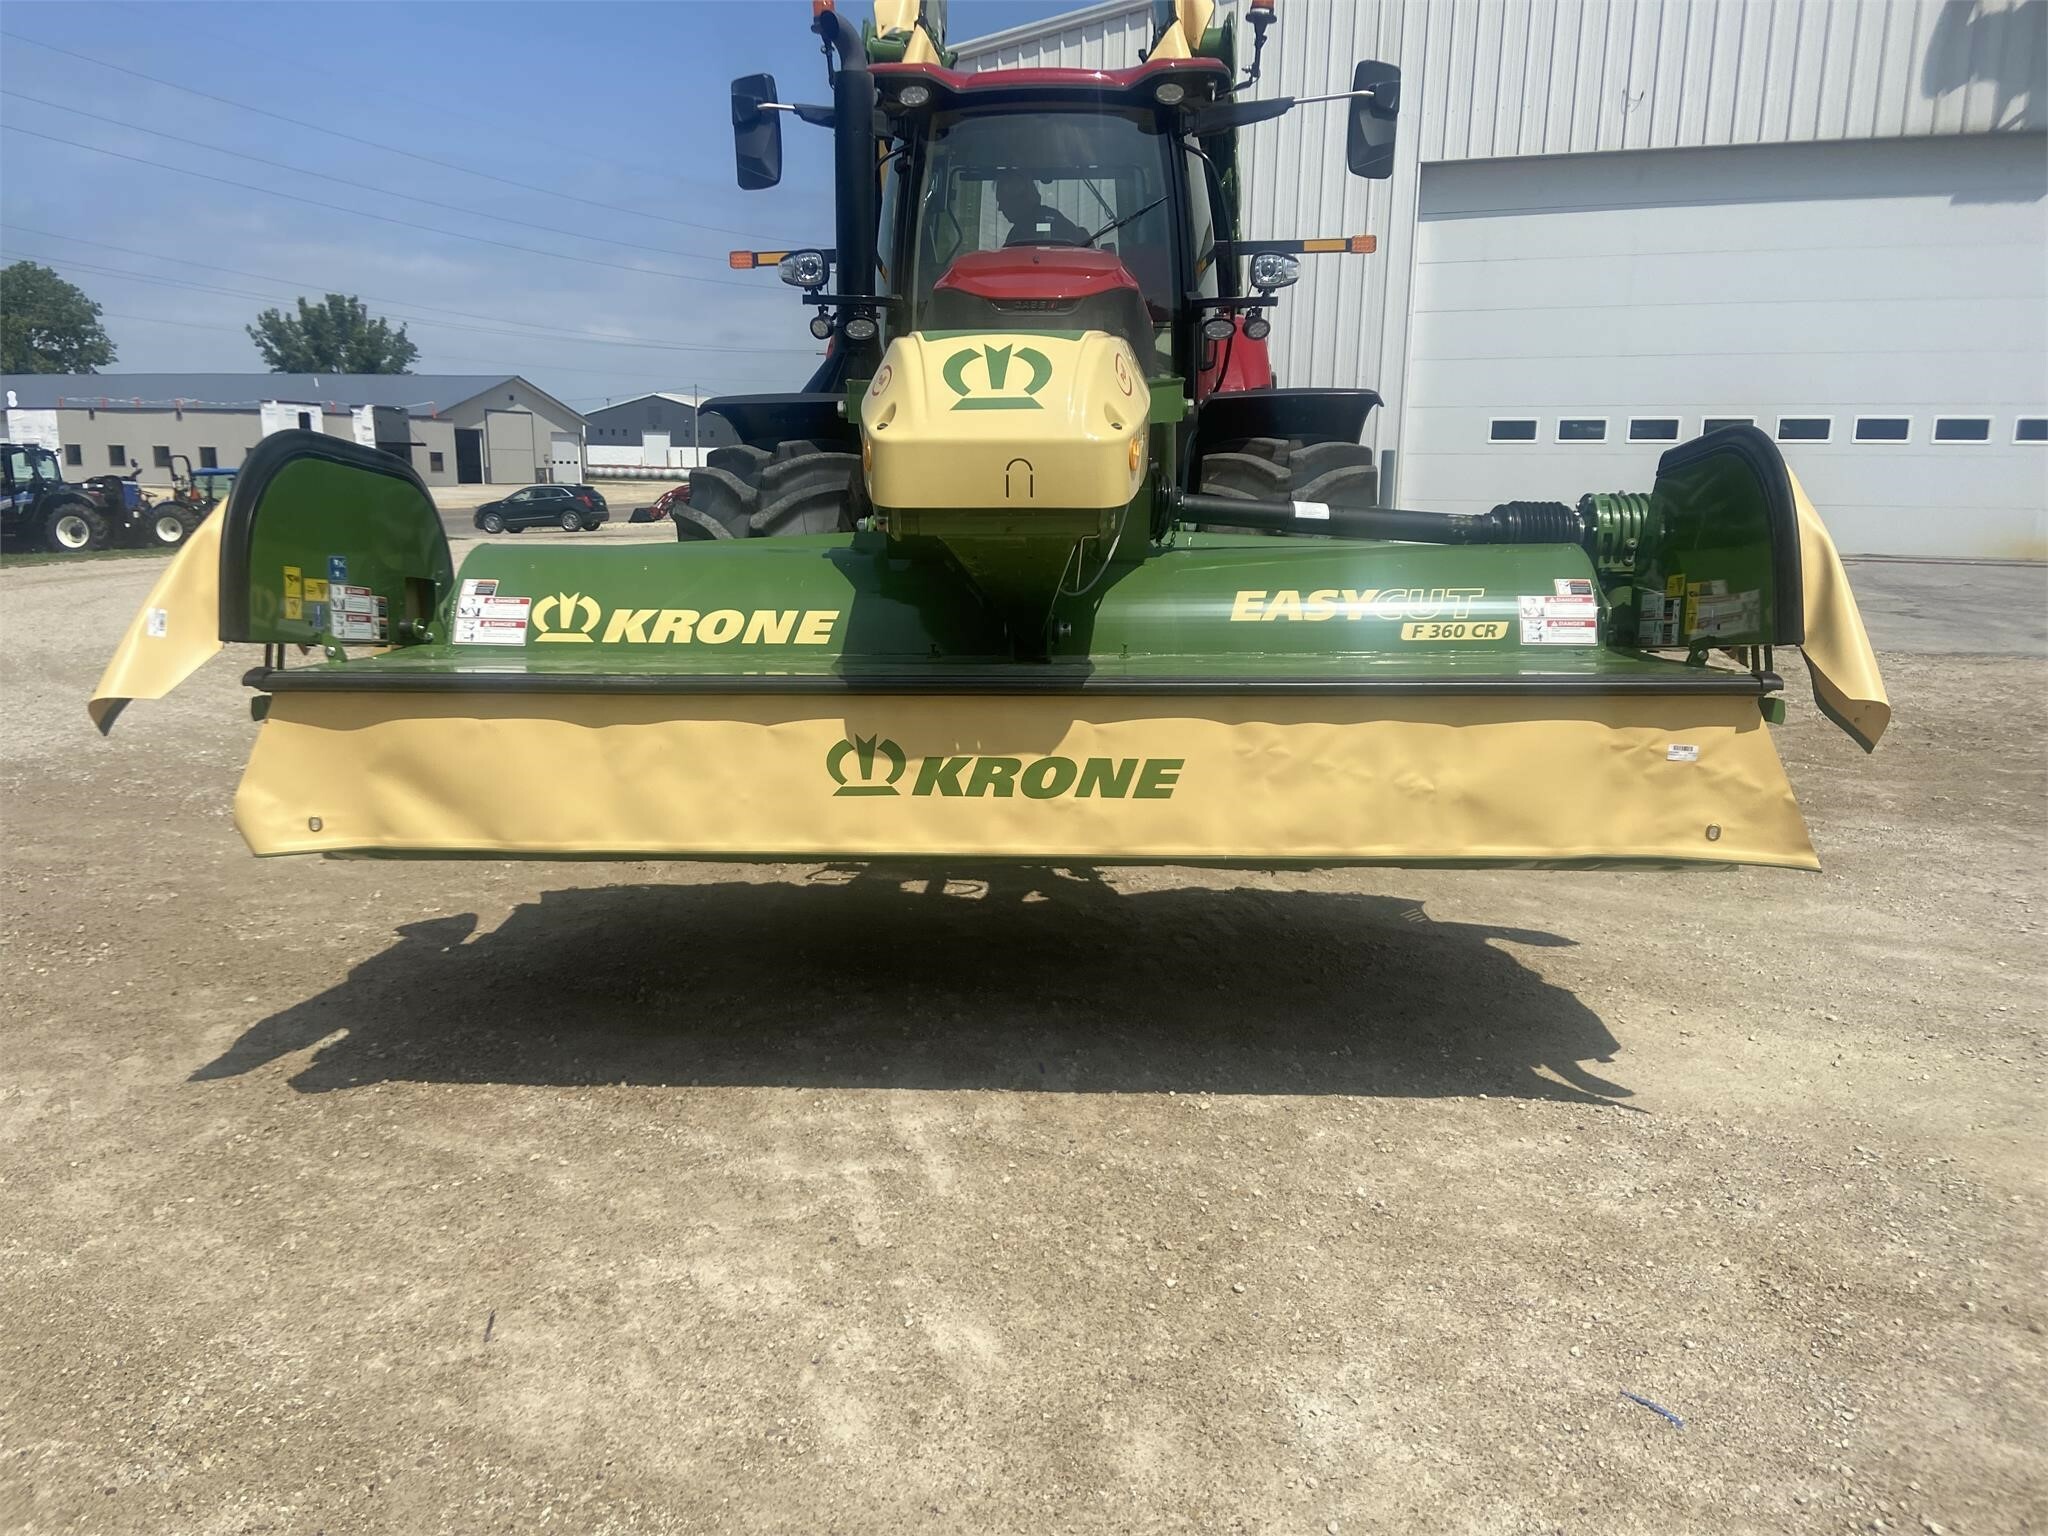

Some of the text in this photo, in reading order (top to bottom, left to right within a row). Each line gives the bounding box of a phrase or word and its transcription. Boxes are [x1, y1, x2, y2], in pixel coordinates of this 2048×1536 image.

[601, 609, 840, 644] KRONE
[1412, 624, 1498, 638] F 360 CR
[912, 756, 1185, 800] KRONE
